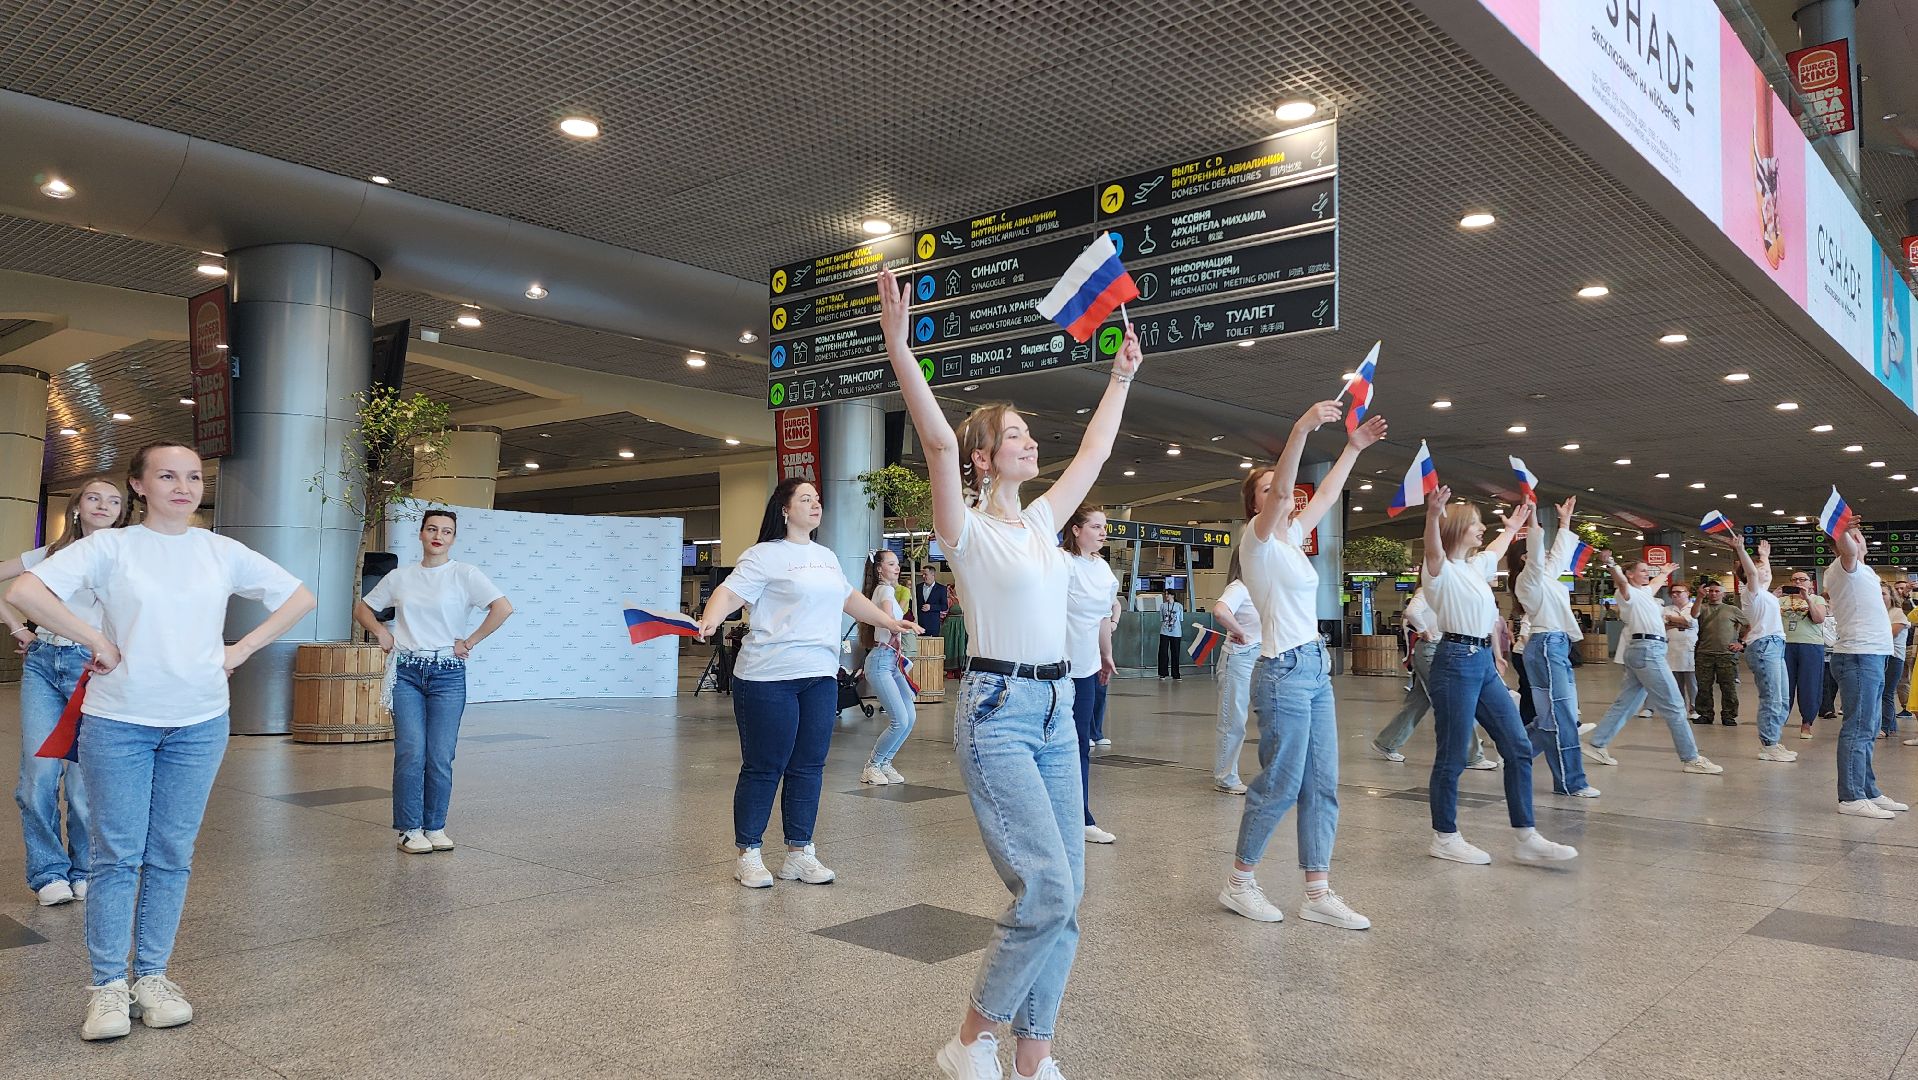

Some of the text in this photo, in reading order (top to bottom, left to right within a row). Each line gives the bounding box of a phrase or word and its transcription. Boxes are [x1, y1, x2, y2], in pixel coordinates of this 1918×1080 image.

[1800, 59, 1835, 74] BURGER
[1800, 67, 1836, 83] KING
[1172, 162, 1200, 178] ВЫЛЕТ
[1215, 156, 1222, 166] D
[1172, 152, 1285, 188] ВНУТРЕННИЕ АВИАЛИНИИ
[1172, 184, 1210, 200] DOMESTIC
[1212, 171, 1262, 189] DEPARTURES
[971, 210, 1057, 238] ВНУТРЕННИЕ АВИАЛИНИИ
[972, 215, 996, 229] ПРИЛЕТ
[1171, 210, 1266, 238] АРХАНГЕЛА МИХАИЛА
[1172, 210, 1211, 225] ЧАСОВНЯ
[971, 235, 1000, 248] DOMESTIC
[1001, 228, 1029, 241] ARRIVALS
[1171, 236, 1200, 248] CHAPEL
[816, 256, 832, 268] ВЫЛЕТ
[834, 251, 853, 263] БИЗНЕС
[816, 262, 848, 276] ВНУТРЕННИЕ
[849, 253, 883, 268] АВИАЛИНИИ
[1170, 255, 1233, 275] ИНФОРМАЦИЯ
[1818, 224, 1861, 309] O'SHADE
[816, 264, 878, 284] DEPARTURES BUSINESS CLASS
[972, 258, 1019, 278] СИНАГОГА
[1170, 266, 1240, 286] МЕСТО ВСТРЕЧИ
[971, 277, 1006, 292] SYNAGOGUE
[1170, 282, 1218, 297] INFORMATION
[1224, 276, 1256, 288] MEETING
[1258, 270, 1280, 282] POINT
[816, 293, 845, 306] FAST TRACK
[816, 301, 848, 315] ВНУТРЕННИЕ
[816, 310, 839, 324] DOMESTIC
[840, 309, 851, 319] FAST
[852, 306, 866, 317] TRACK
[970, 297, 1043, 320] КОМНАТА ХРАНЕН
[1226, 304, 1275, 323] ТУАЛЕТ
[970, 313, 1042, 333] WEAPON STORAGE ROOM
[815, 330, 857, 344] РОЗЫСК БАГАЖА
[1226, 326, 1253, 338] TOILET
[815, 334, 882, 353] ВНУТРЕННИЕ АВИАЛИНИИ
[1021, 339, 1063, 355] Яндекс Go
[815, 350, 838, 362] DOMESTIC
[970, 348, 1012, 364] ВЫХОД 2
[946, 361, 959, 370] EXIT
[970, 368, 983, 376] EXIT
[1021, 361, 1034, 369] TAXI
[839, 369, 884, 385] ТРАНСПОРТ
[838, 386, 854, 396] PUBLIC
[855, 382, 883, 393] TRANSPORT
[198, 391, 225, 423] ДВА
[784, 418, 809, 428] BURGER
[785, 426, 810, 440] KING
[783, 452, 814, 466] ЗДЕСЬ
[1140, 526, 1145, 537] 3
[700, 552, 708, 561] 64
